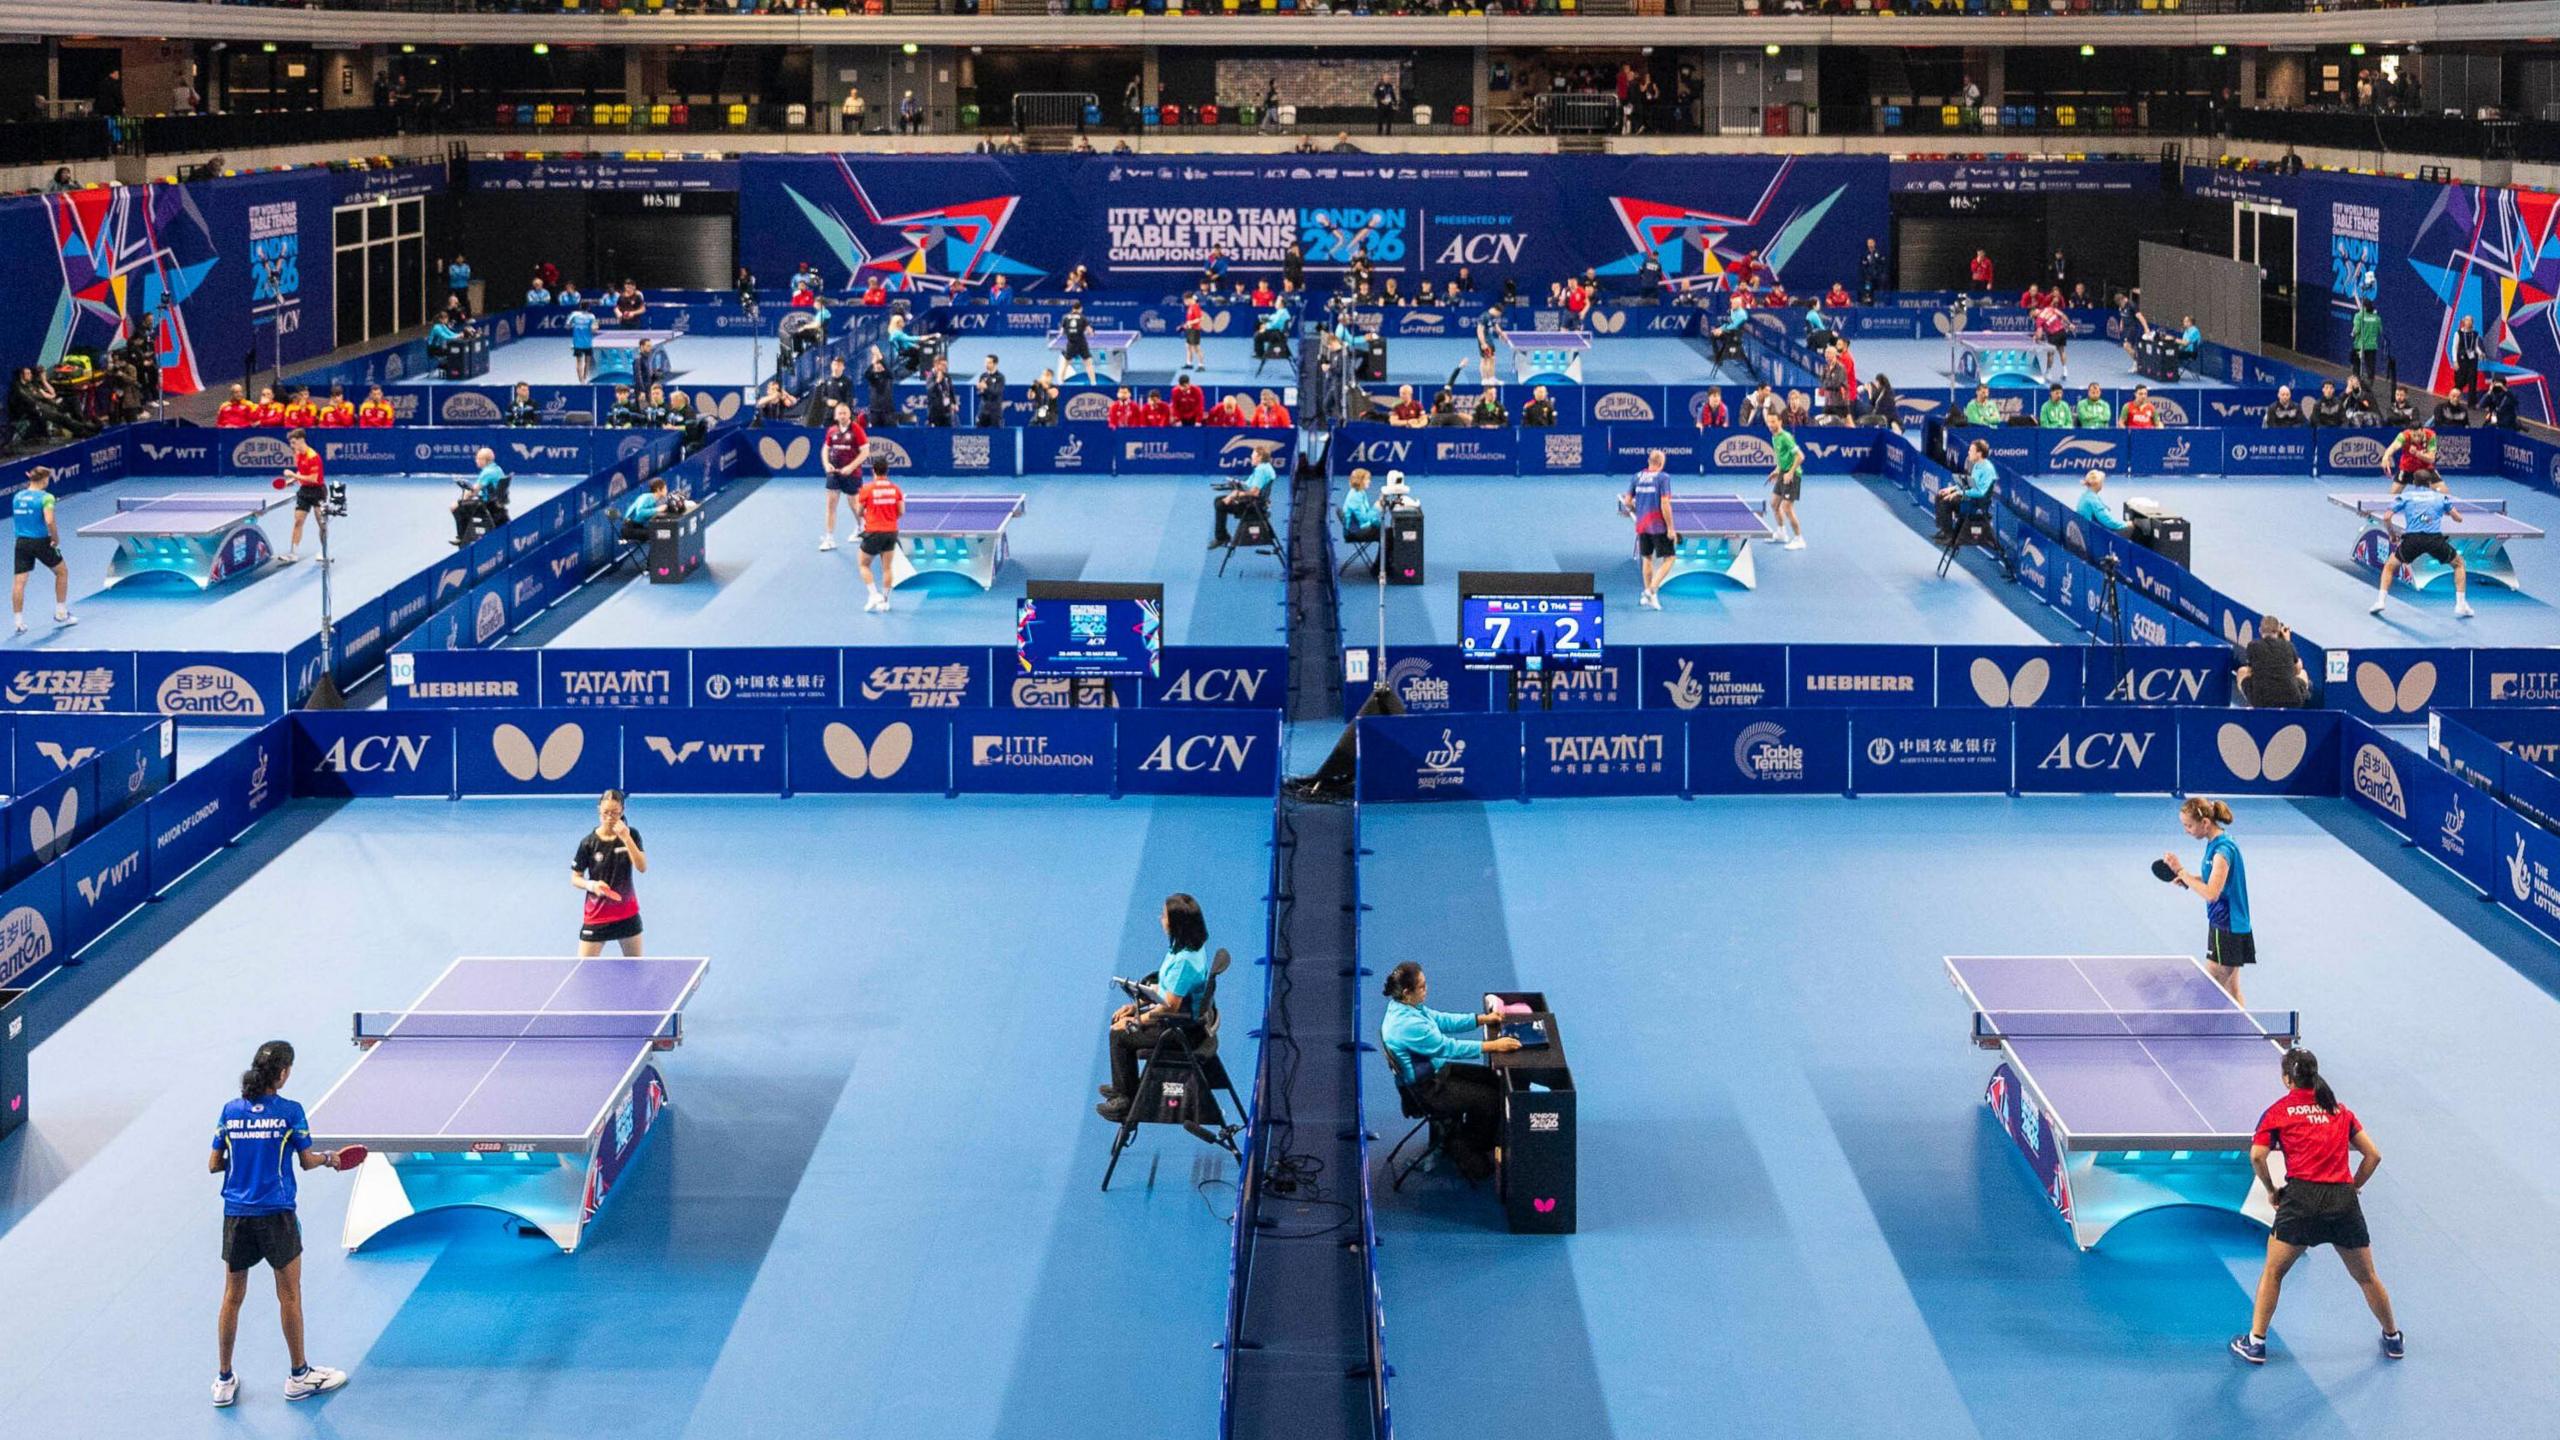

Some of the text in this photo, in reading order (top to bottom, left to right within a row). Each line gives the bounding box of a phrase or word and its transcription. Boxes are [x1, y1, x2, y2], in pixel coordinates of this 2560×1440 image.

[1108, 208, 1297, 225] ITTF WORLD TEAM
[1300, 208, 1406, 228] LONDON
[1434, 216, 1513, 226] PRESENTED BY
[1108, 226, 1297, 248] TABLE TENNIS
[1301, 230, 1406, 262] 2026
[1435, 233, 1528, 265] ACN
[1108, 248, 1296, 262] CHAMPIONSHPS FINAL
[1648, 314, 1691, 330] ACN
[175, 448, 207, 459] WTT
[547, 447, 579, 459] WTT
[1347, 440, 1412, 463] ACN
[1841, 447, 1872, 458] WTT
[2333, 450, 2382, 468] Gante
[2050, 457, 2117, 469] LI-NING
[2154, 582, 2172, 601] WTT
[1521, 601, 1528, 612] 1
[1538, 601, 1548, 613] 0
[1484, 617, 1580, 650] 7 2
[1464, 637, 1475, 650] 0
[393, 664, 411, 678] 10
[1351, 660, 1364, 674] 11
[2329, 661, 2346, 675] 12
[176, 673, 234, 690] 百岁山
[735, 674, 826, 690] 中国农业银行
[1410, 677, 1449, 690] Table
[1708, 672, 1731, 682] THE
[1806, 675, 1914, 691] LIEBHERR
[2105, 668, 2212, 701] ACN
[2520, 672, 2559, 689] ITTF
[409, 681, 519, 698] LIEBHERR
[1160, 669, 1268, 702] ACN
[1708, 683, 1765, 693] NATIONAL
[907, 691, 967, 708] DHS
[1402, 688, 1449, 701] Tennis
[1708, 695, 1760, 705] LOTTERY
[2520, 689, 2560, 699] FOUND
[53, 696, 111, 712] DHS
[708, 744, 765, 762] WTT
[1006, 736, 1048, 754] ITTF
[1760, 744, 1803, 759] Table
[1899, 737, 1997, 753] 中国农业银行
[2036, 731, 2156, 770] ACN
[2518, 744, 2560, 762] WT
[313, 735, 432, 773] ACN
[1005, 755, 1093, 767] FOUNDATION
[1138, 735, 1257, 772] ACN
[1752, 757, 1803, 771] Tennis
[2362, 750, 2391, 780] 百岁山
[1762, 769, 1803, 782] England
[157, 823, 181, 849] MAYOR
[181, 815, 192, 833] OF
[191, 798, 220, 828] LONDON
[111, 850, 140, 888] WTT
[2533, 861, 2549, 880] THE
[2533, 877, 2560, 905] NATION
[0, 931, 46, 982] anten
[226, 1118, 288, 1129] SRI LANKA
[1529, 1112, 1559, 1120] LONDON
[2306, 1115, 2330, 1124] THA
[1529, 1119, 1559, 1130] 2026
